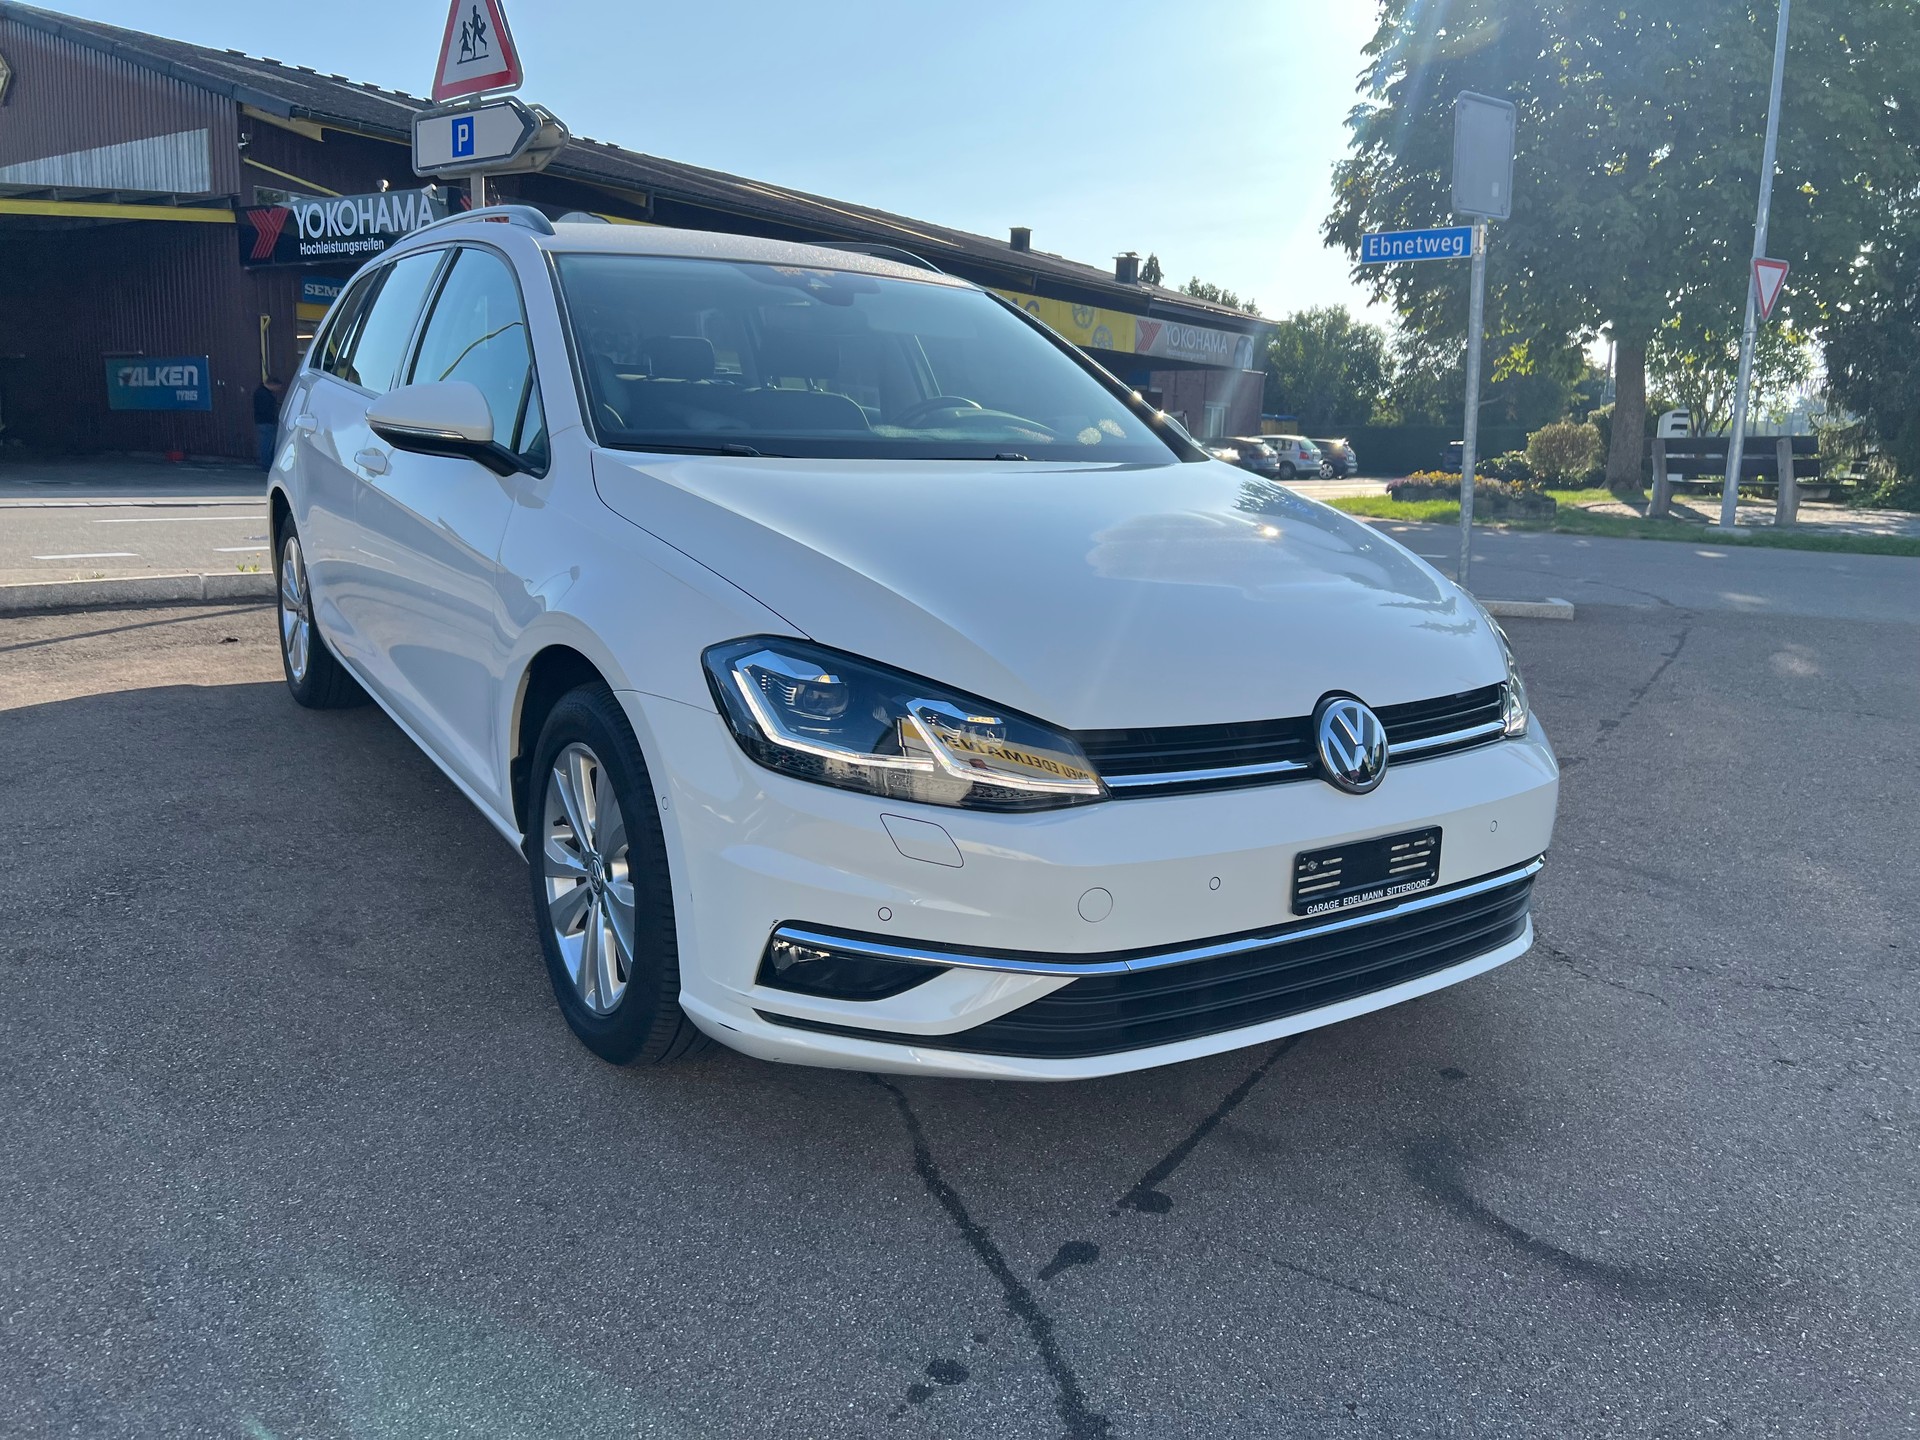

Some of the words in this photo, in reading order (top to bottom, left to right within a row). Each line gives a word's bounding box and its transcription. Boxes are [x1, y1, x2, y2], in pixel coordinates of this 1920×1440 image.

[457, 123, 469, 153] P
[292, 193, 434, 240] YOKOHAMA
[300, 237, 385, 256] Hochleistungsreifen
[1369, 236, 1464, 256] Ebnetweg
[304, 283, 345, 298] SEM
[1165, 325, 1228, 355] YOKOHAMA
[118, 365, 198, 387] FALKEN
[1320, 699, 1388, 787] VW
[1306, 899, 1340, 915] GARAGE
[1343, 889, 1384, 906] EDELMANN
[1386, 878, 1431, 896] SITTERDORF
